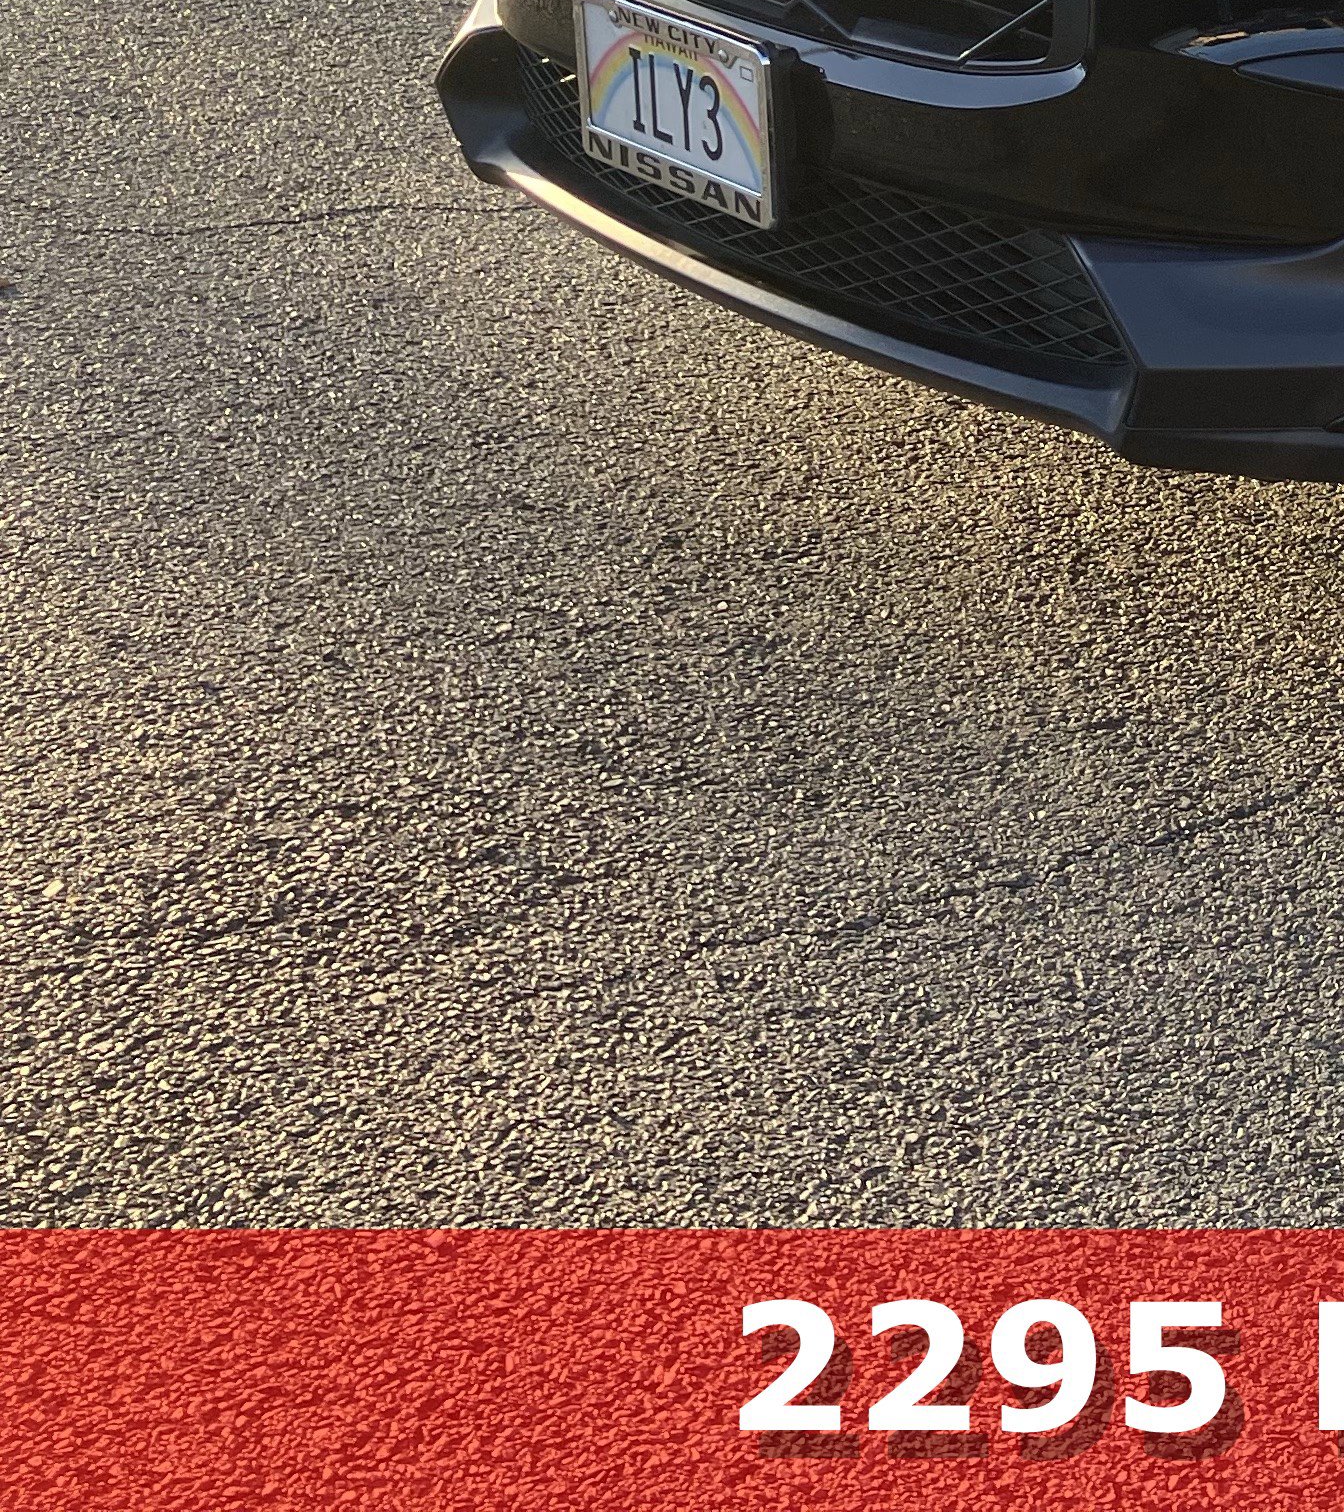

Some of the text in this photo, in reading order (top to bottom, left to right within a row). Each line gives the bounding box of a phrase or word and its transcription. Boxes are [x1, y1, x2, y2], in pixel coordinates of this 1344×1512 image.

[617, 6, 717, 55] NEW CITY
[628, 46, 724, 162] ILY3
[588, 131, 762, 224] NISSAN
